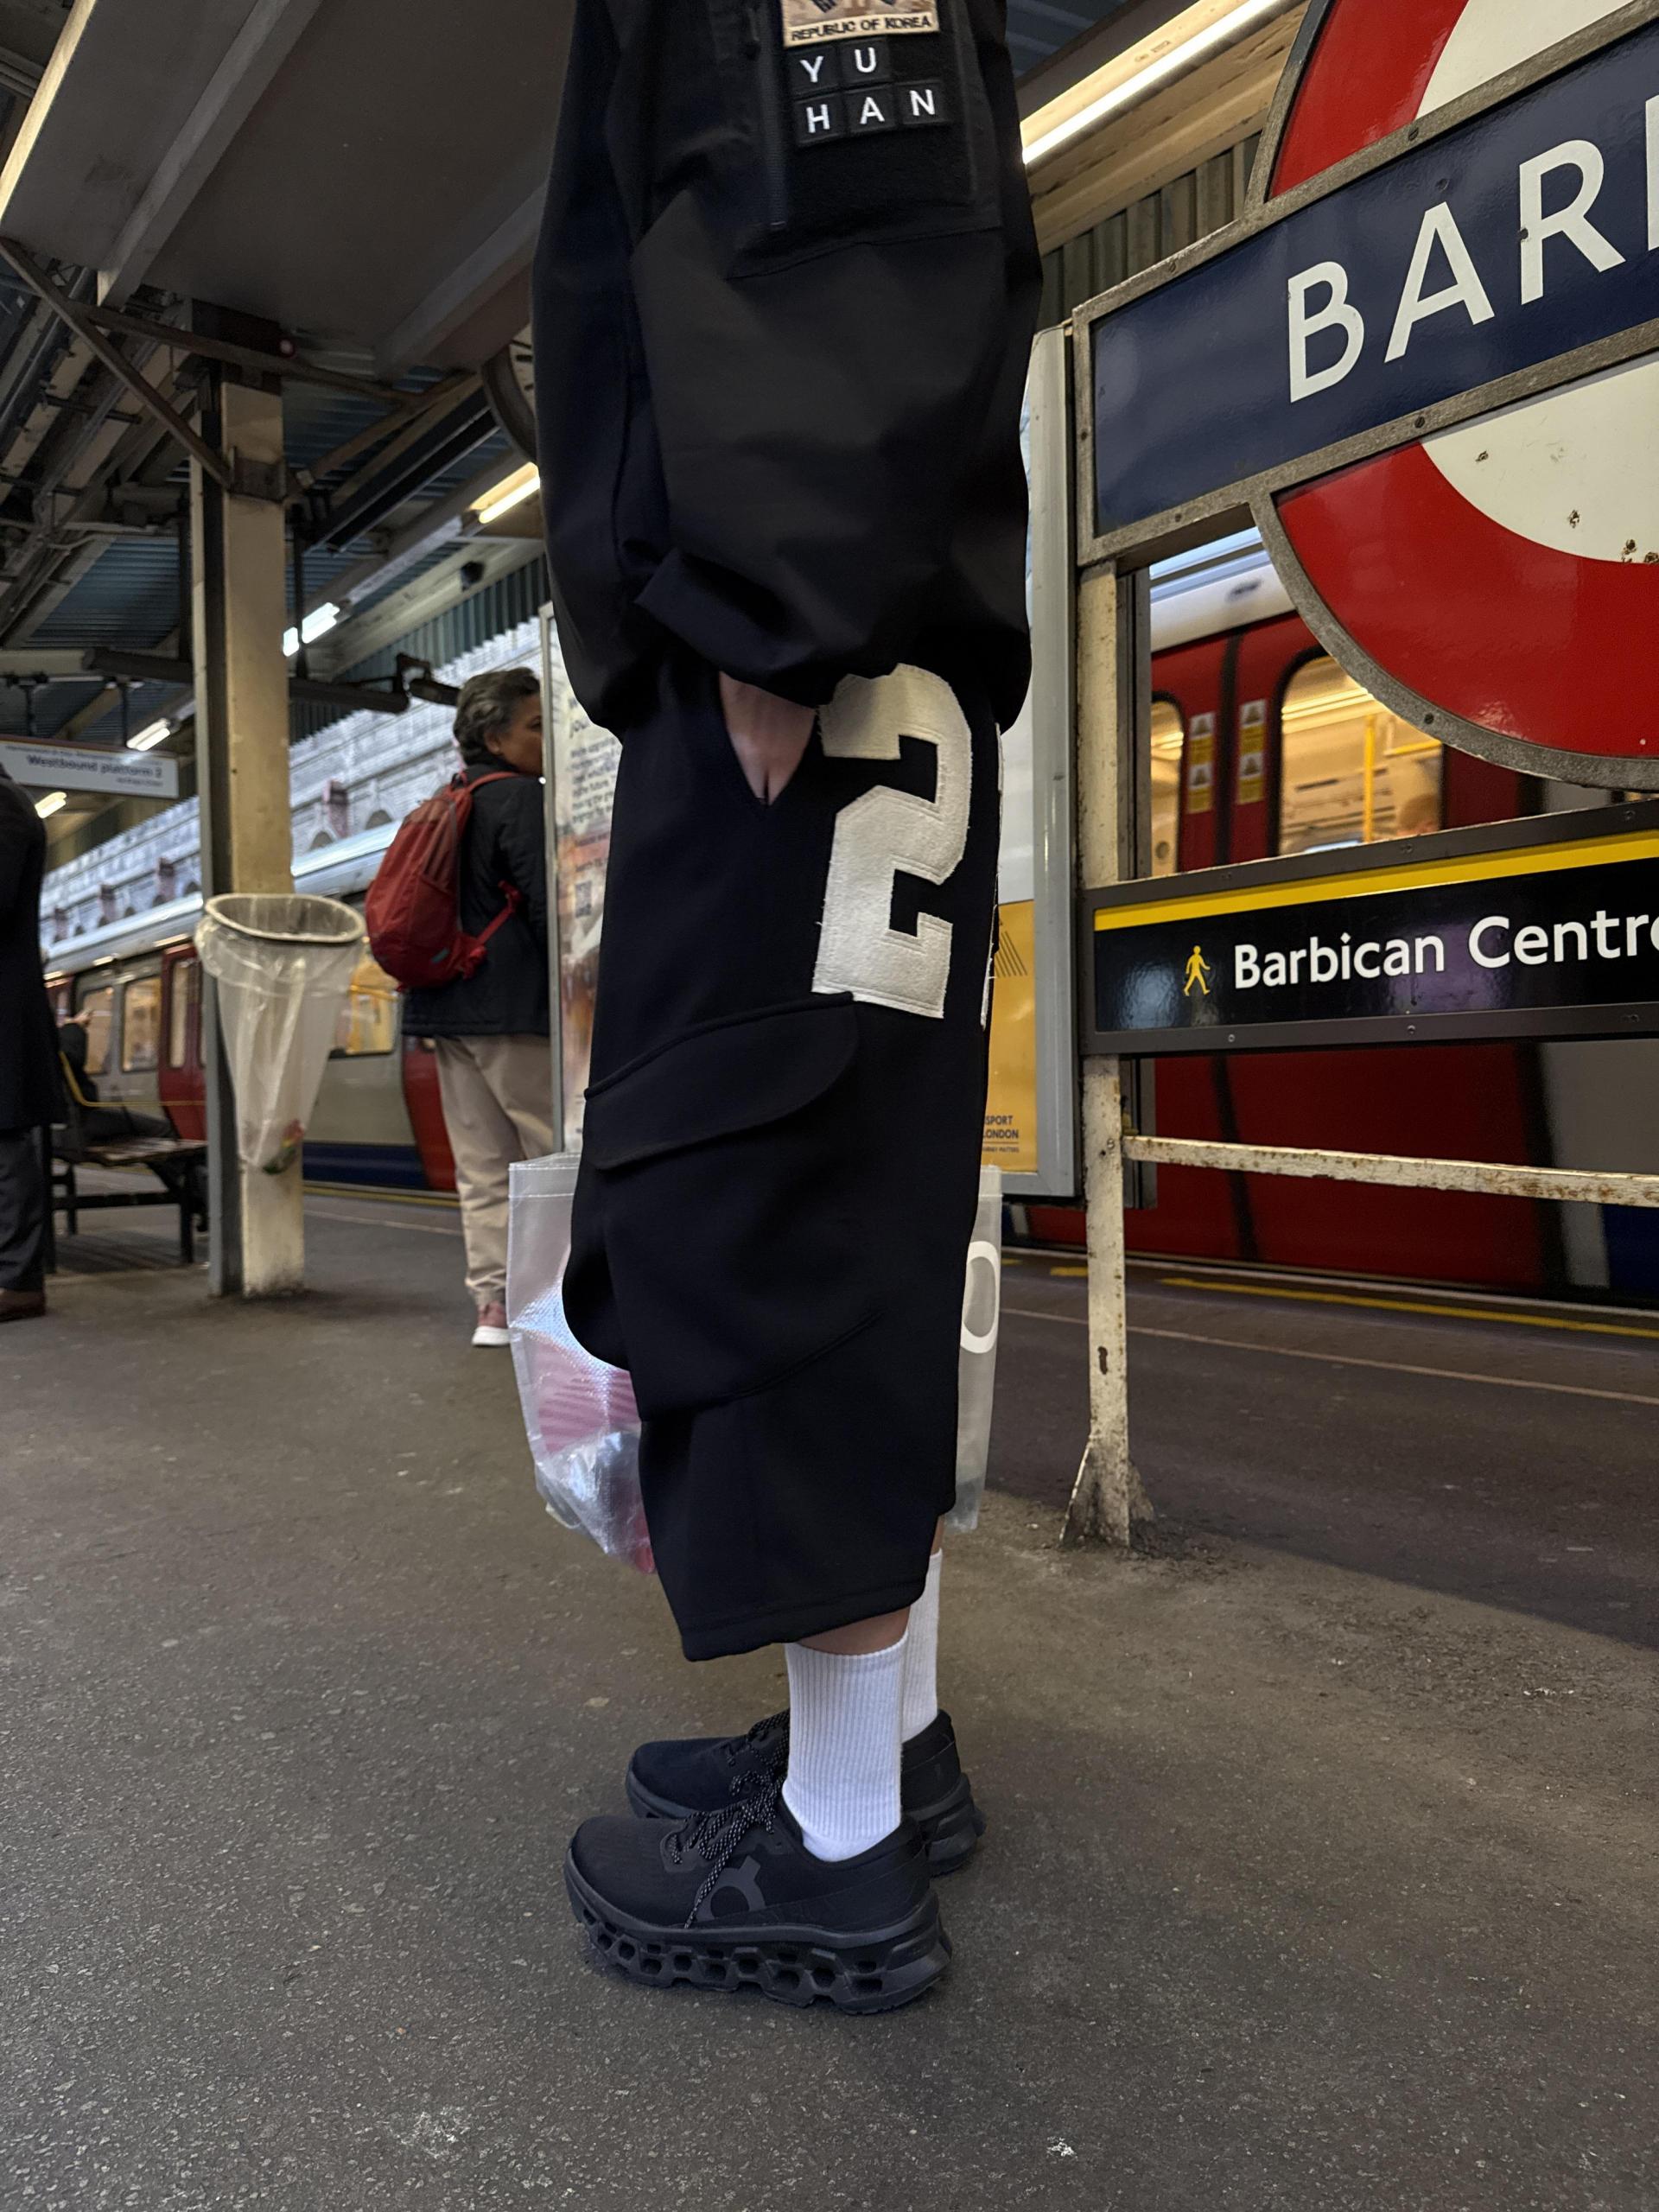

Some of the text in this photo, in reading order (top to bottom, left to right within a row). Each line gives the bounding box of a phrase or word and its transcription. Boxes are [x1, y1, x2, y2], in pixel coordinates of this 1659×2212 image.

[791, 16, 931, 41] REPUBLIC OF KOREA
[805, 89, 936, 134] HAN
[26, 754, 98, 772] Westbound
[100, 764, 154, 777] platform
[811, 663, 973, 1020] 2
[1234, 910, 1659, 989] Barbican Centr
